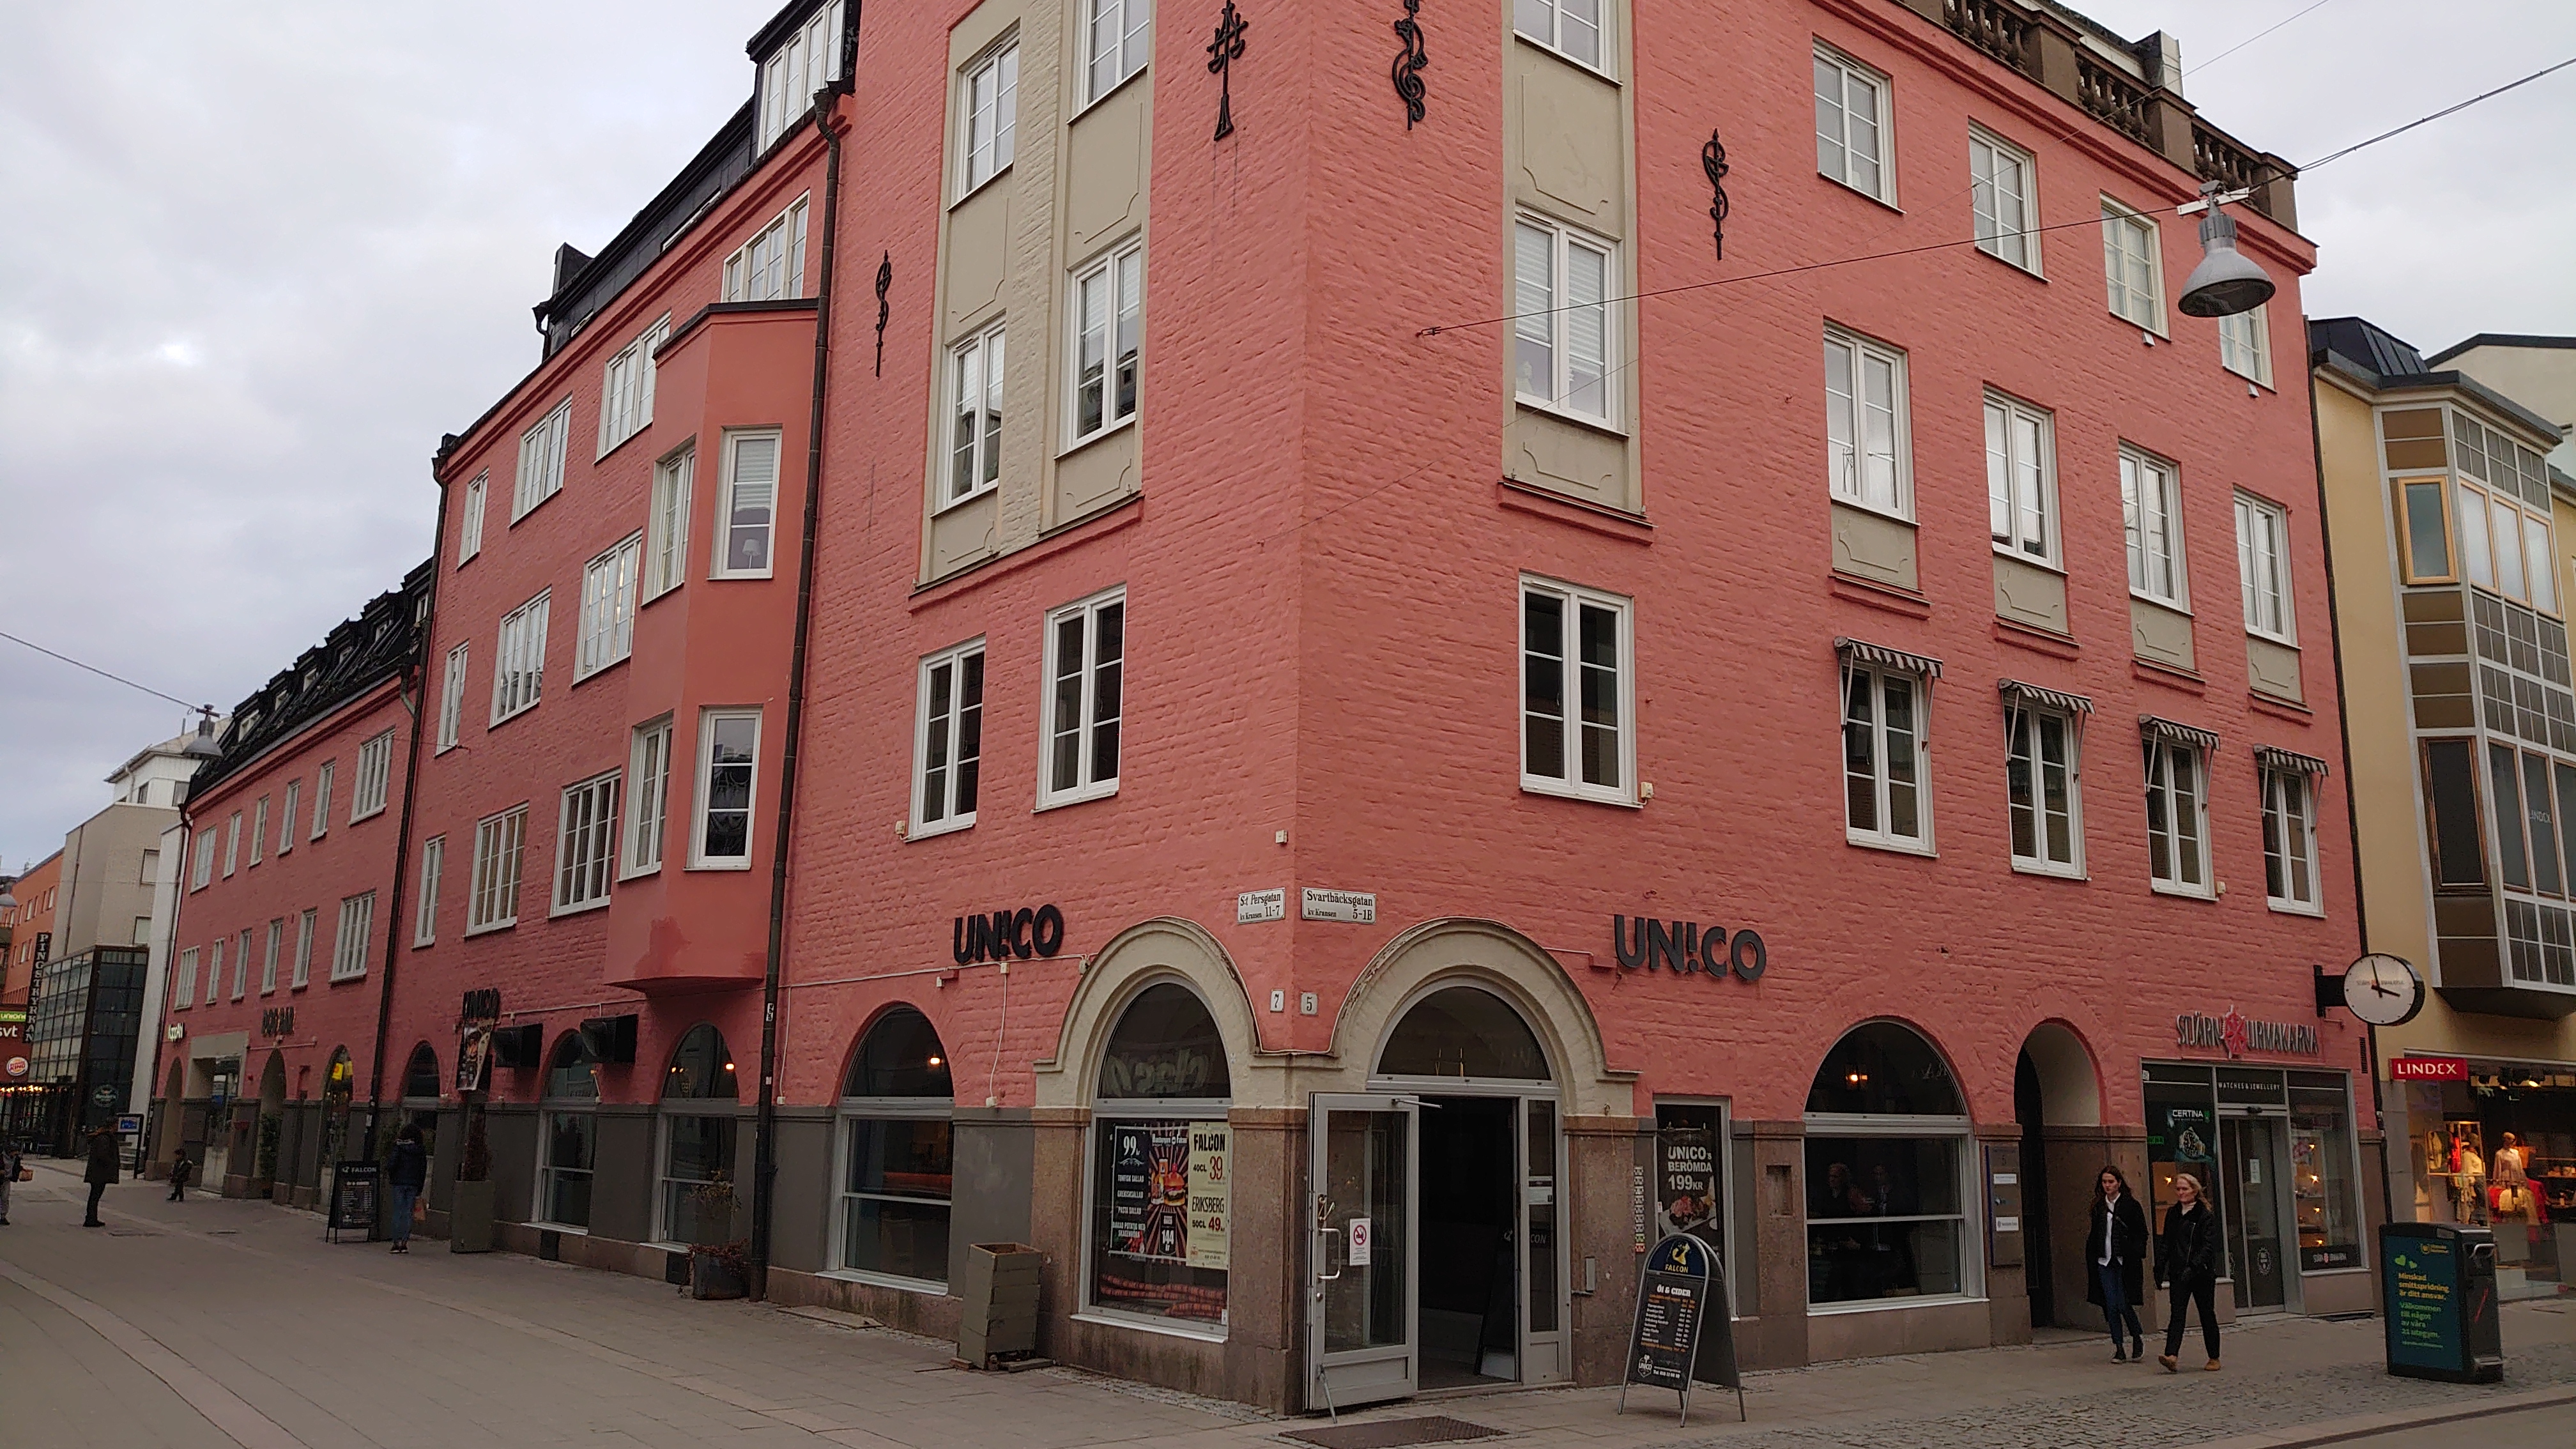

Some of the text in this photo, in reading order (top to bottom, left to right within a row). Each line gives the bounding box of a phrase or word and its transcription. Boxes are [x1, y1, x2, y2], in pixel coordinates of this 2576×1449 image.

[1250, 893, 1281, 906] Persgatan
[1307, 890, 1373, 908] Svartbäcksgatan
[1264, 905, 1280, 917] 11-7
[1353, 908, 1372, 921] 5-1B
[25, 934, 49, 1041] PINGSTKYRKAN
[1274, 993, 1280, 1008] 7
[1306, 996, 1312, 1011] 5
[2176, 1010, 2319, 1054] STJÄRN URMAKARNA
[2397, 1063, 2457, 1075] LINDEX
[1123, 1135, 1137, 1156] 99
[1193, 1133, 1225, 1151] FALCON
[1193, 1163, 1207, 1172] 40CL
[1209, 1156, 1223, 1180] 39
[1667, 1160, 1713, 1172] BERÖMDA
[1192, 1196, 1224, 1213] ERIKSBERG
[1192, 1220, 1206, 1229] 50CL
[1208, 1216, 1221, 1232] 49
[1162, 1229, 1174, 1245] 144
[1664, 1264, 1689, 1273] FALCON
[1671, 1287, 1691, 1297] CIDER
